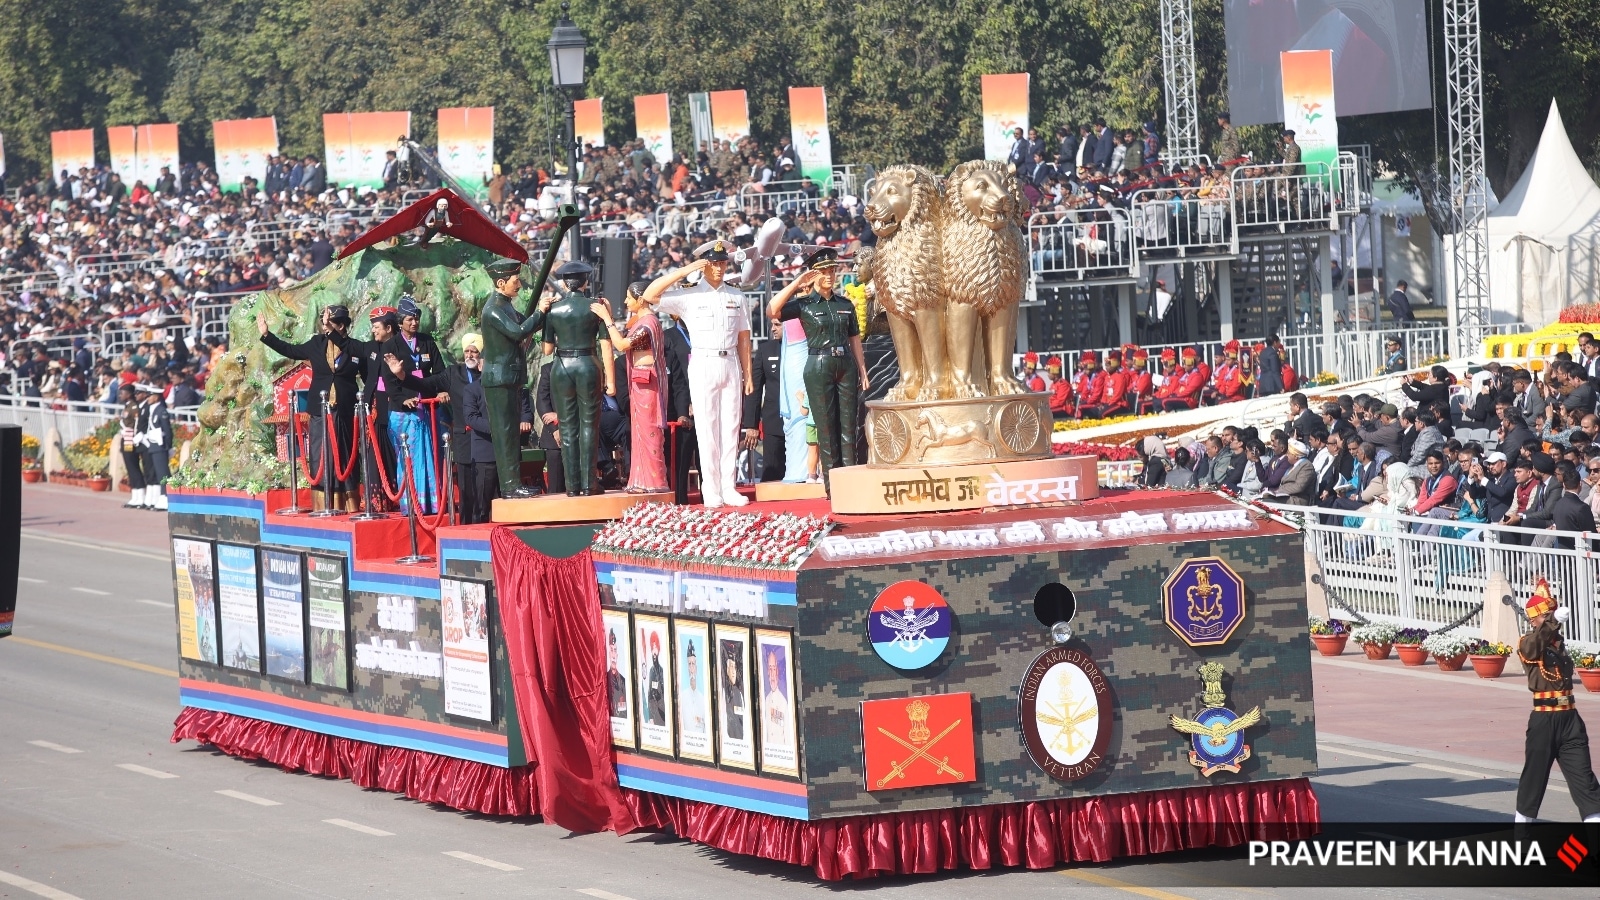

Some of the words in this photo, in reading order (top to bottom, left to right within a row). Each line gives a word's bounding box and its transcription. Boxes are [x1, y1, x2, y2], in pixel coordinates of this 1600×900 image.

[882, 470, 951, 505] सत्यमेव
[984, 473, 1078, 506] वेटरन्स
[821, 529, 934, 557] विकसित
[932, 528, 1000, 547] भारत
[1000, 521, 1046, 542] की
[270, 558, 287, 574] INDIAN
[287, 560, 299, 575] NAVY
[444, 627, 463, 643] OROP
[1025, 663, 1046, 701] INDIAN
[1045, 649, 1081, 667] ARMED
[1080, 657, 1107, 694] FORCES
[1043, 751, 1103, 779] VETERAN
